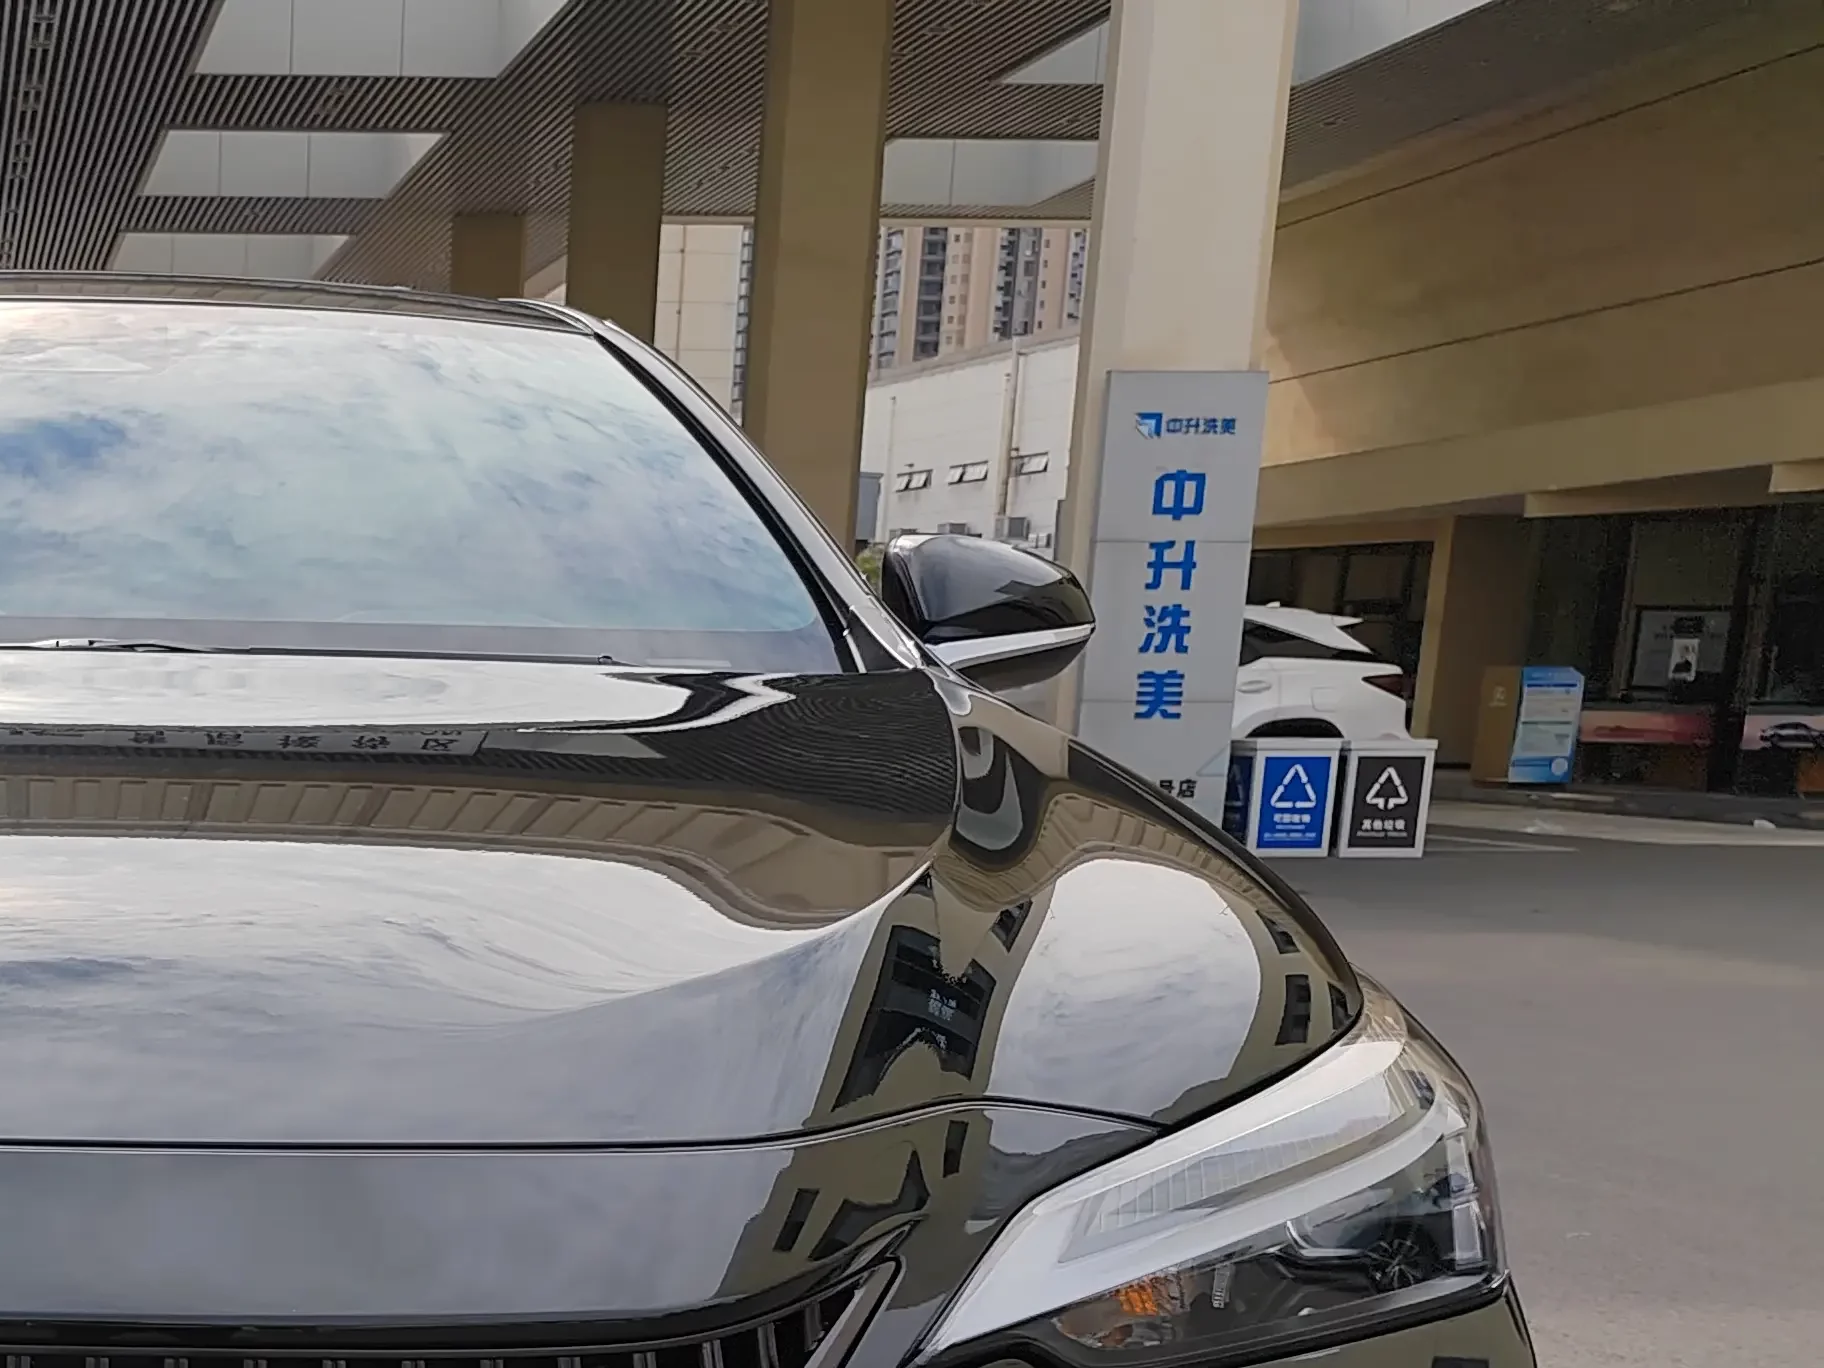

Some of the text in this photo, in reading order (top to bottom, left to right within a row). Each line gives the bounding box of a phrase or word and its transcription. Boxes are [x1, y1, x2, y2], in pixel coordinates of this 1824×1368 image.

[1164, 417, 1237, 435] 中升洗美
[1134, 470, 1207, 720] 中升洗美
